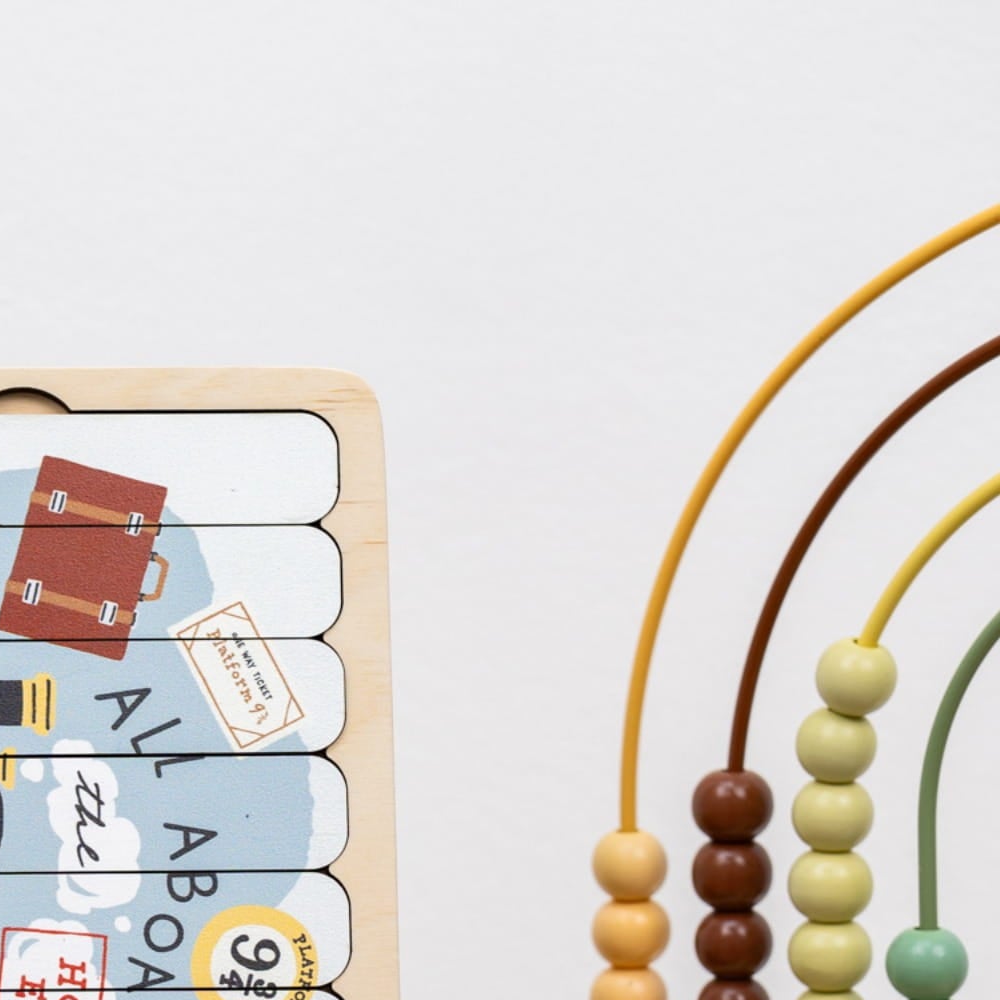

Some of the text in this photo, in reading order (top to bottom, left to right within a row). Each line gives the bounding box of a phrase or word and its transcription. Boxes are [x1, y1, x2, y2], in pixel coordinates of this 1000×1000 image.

[206, 628, 252, 704] Platform
[241, 650, 257, 669] WAY
[252, 671, 273, 700] TICKET
[94, 687, 206, 779] ALL
[75, 770, 106, 868] the
